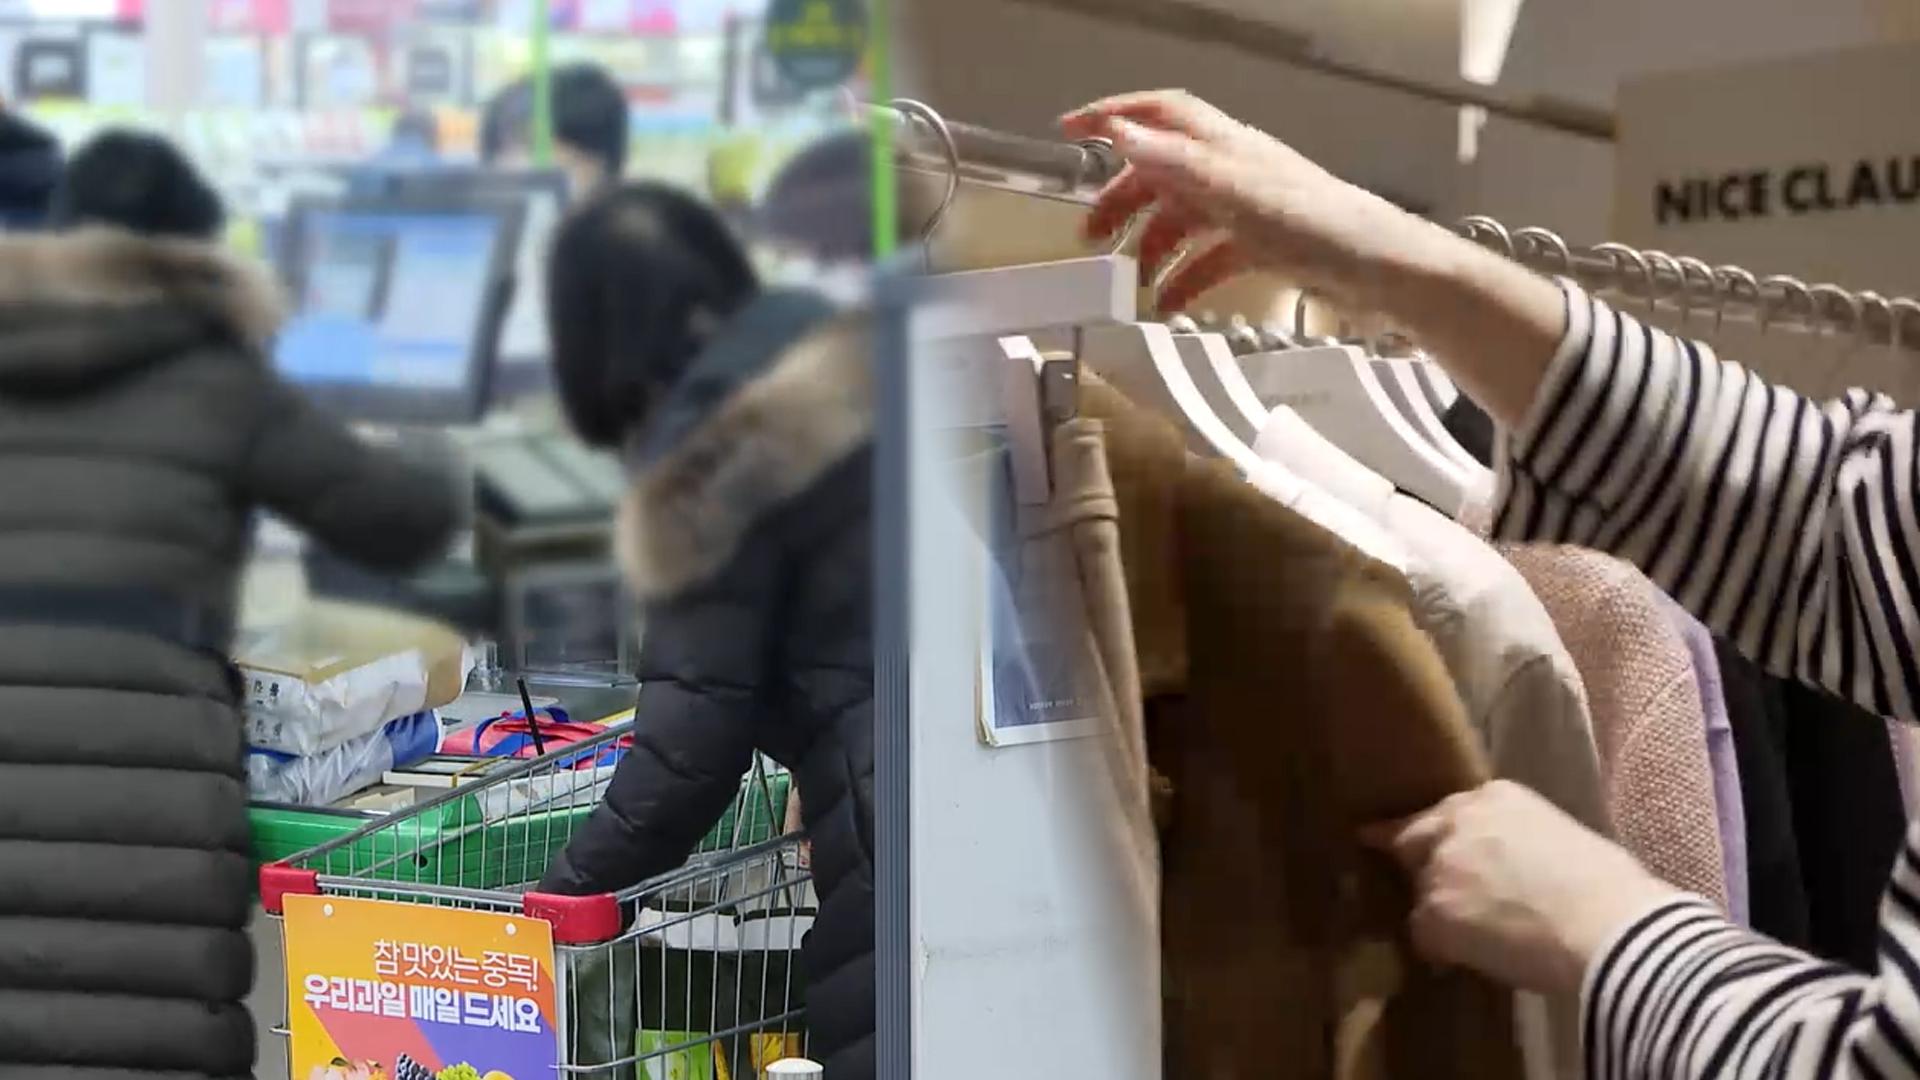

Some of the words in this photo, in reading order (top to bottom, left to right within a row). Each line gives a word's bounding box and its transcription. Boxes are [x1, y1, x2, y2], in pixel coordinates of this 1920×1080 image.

[1655, 171, 1771, 224] NICE
[1782, 154, 1920, 213] CLAU
[373, 938, 400, 976] 참
[402, 942, 479, 984] 맛있는
[303, 974, 406, 1018] 우리과일
[409, 986, 460, 1025] 매일
[463, 993, 541, 1033] 드세요
